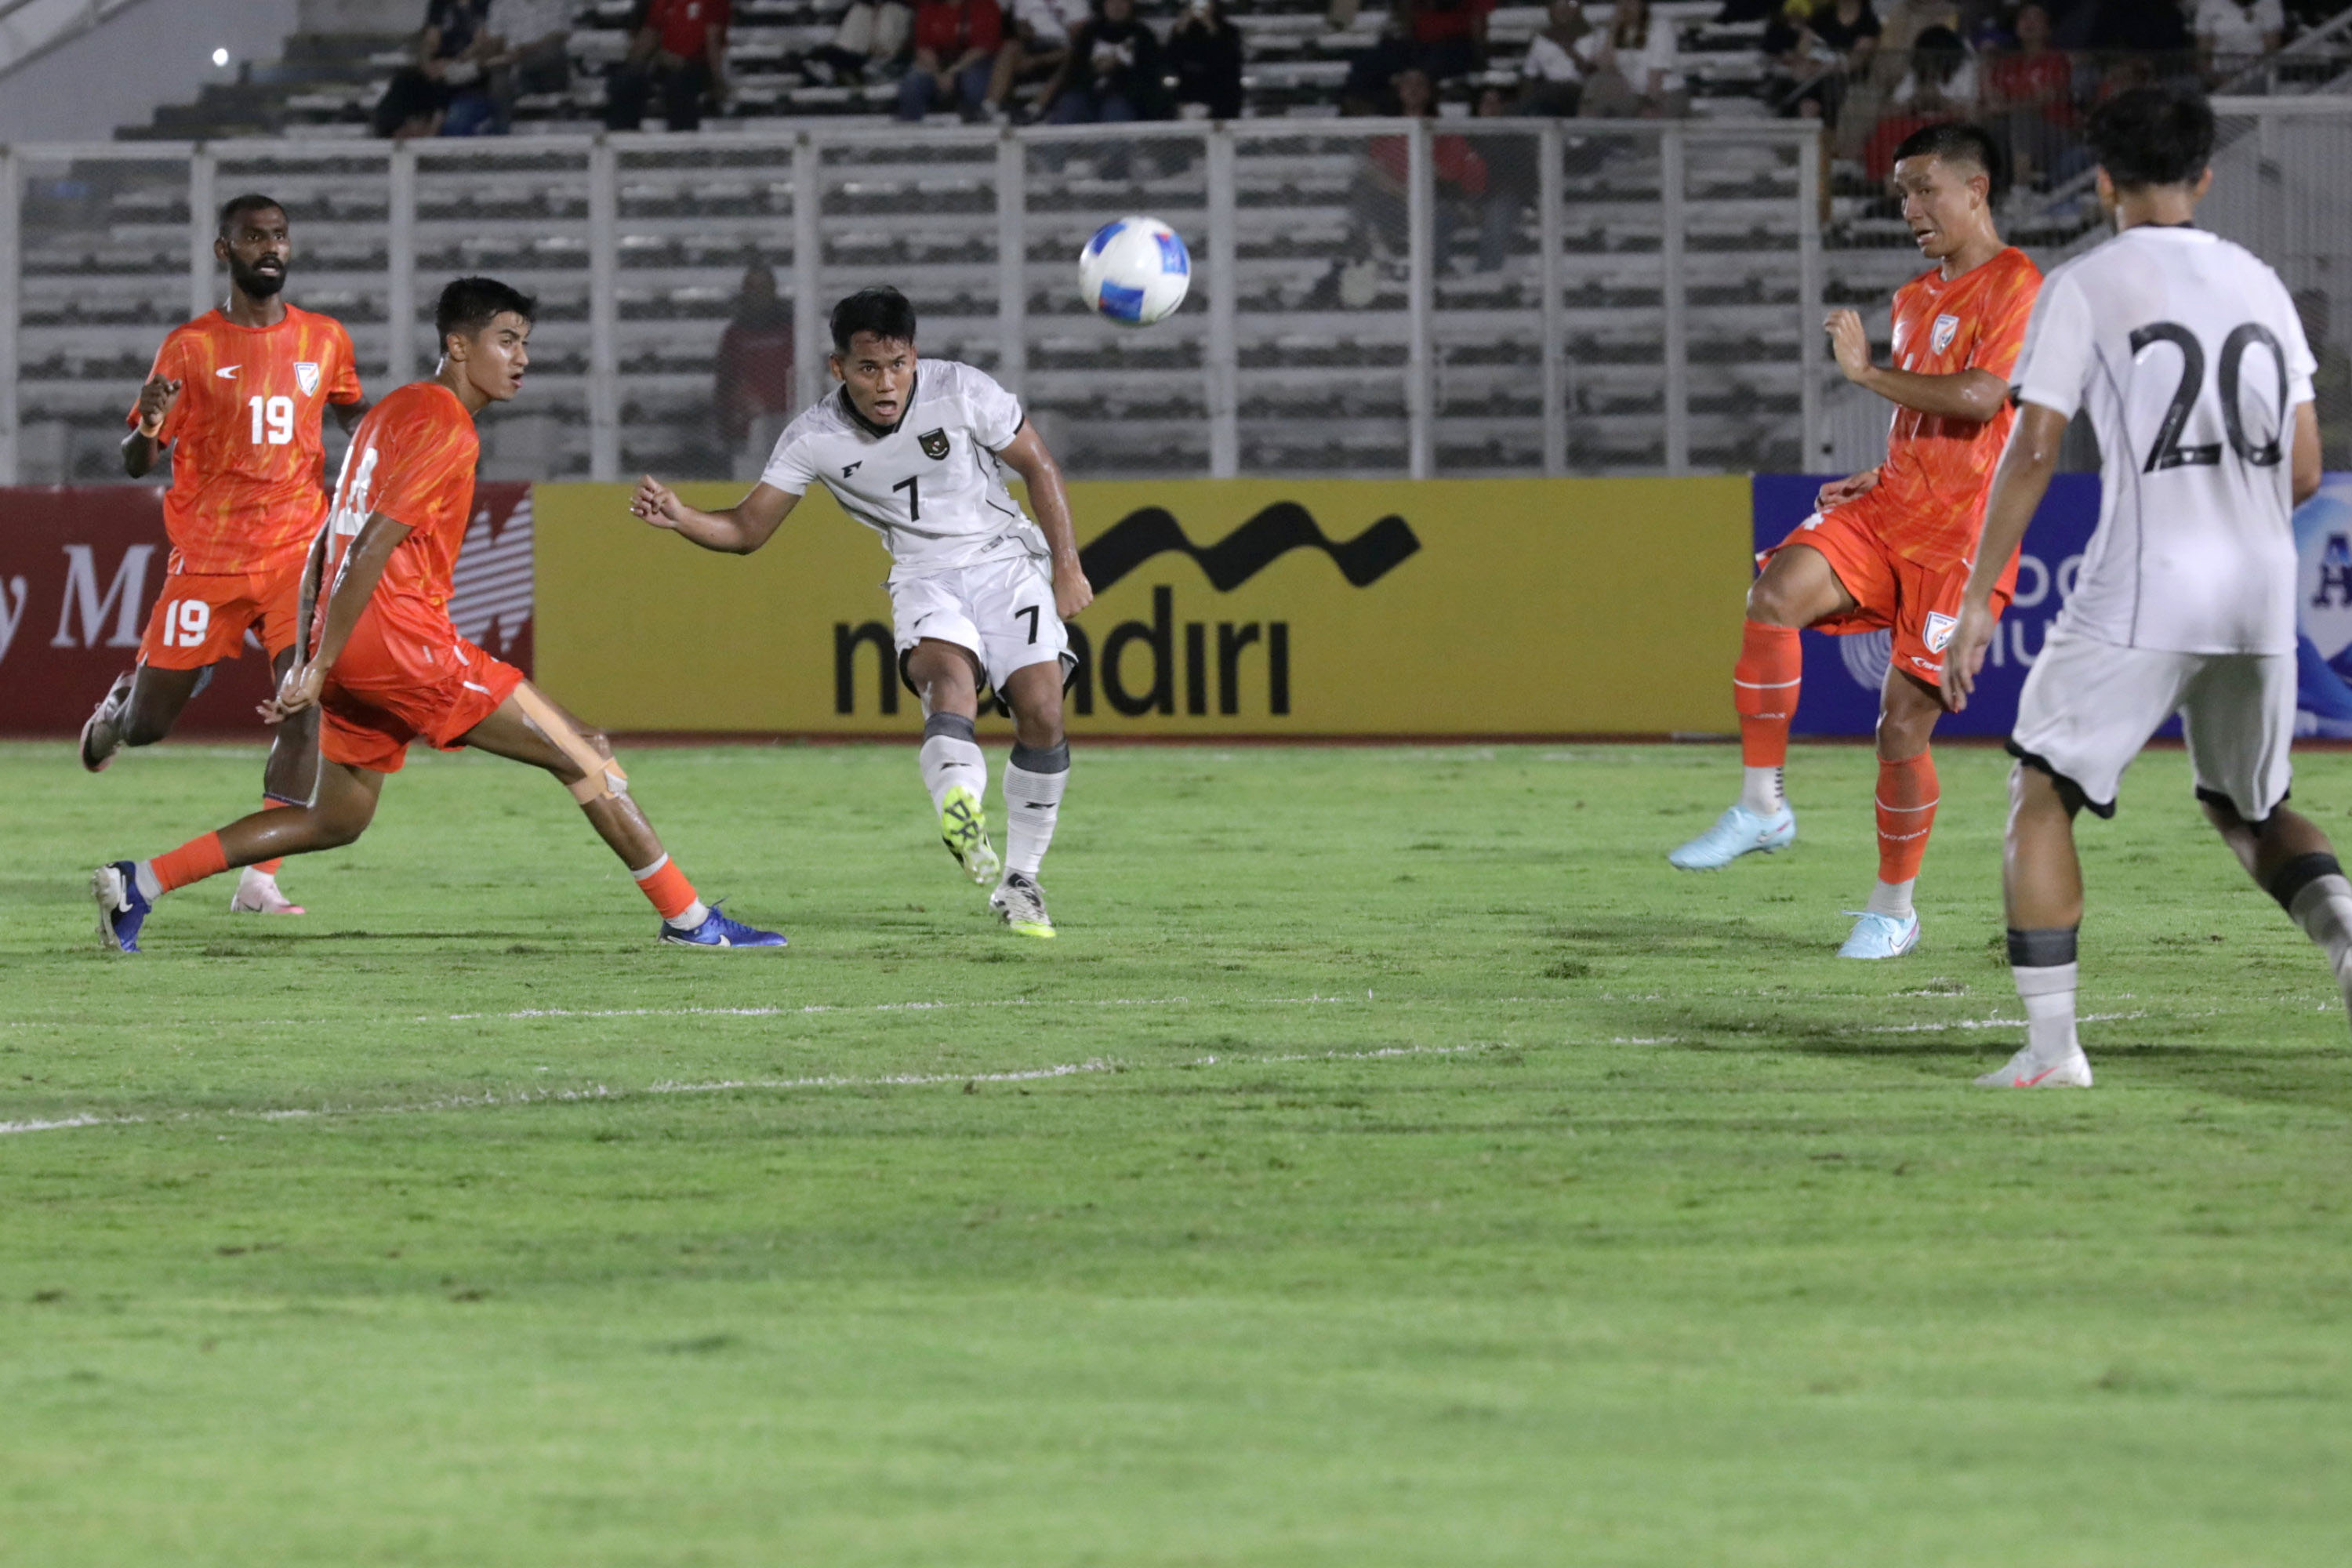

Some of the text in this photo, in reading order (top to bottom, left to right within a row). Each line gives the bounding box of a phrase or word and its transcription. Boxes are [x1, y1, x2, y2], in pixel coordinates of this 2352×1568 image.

[248, 395, 295, 445] 19
[2129, 320, 2288, 475] 20
[892, 475, 920, 522] 7
[162, 599, 210, 647] 19
[1014, 604, 1040, 645] 7
[834, 585, 1290, 717] mndiri
